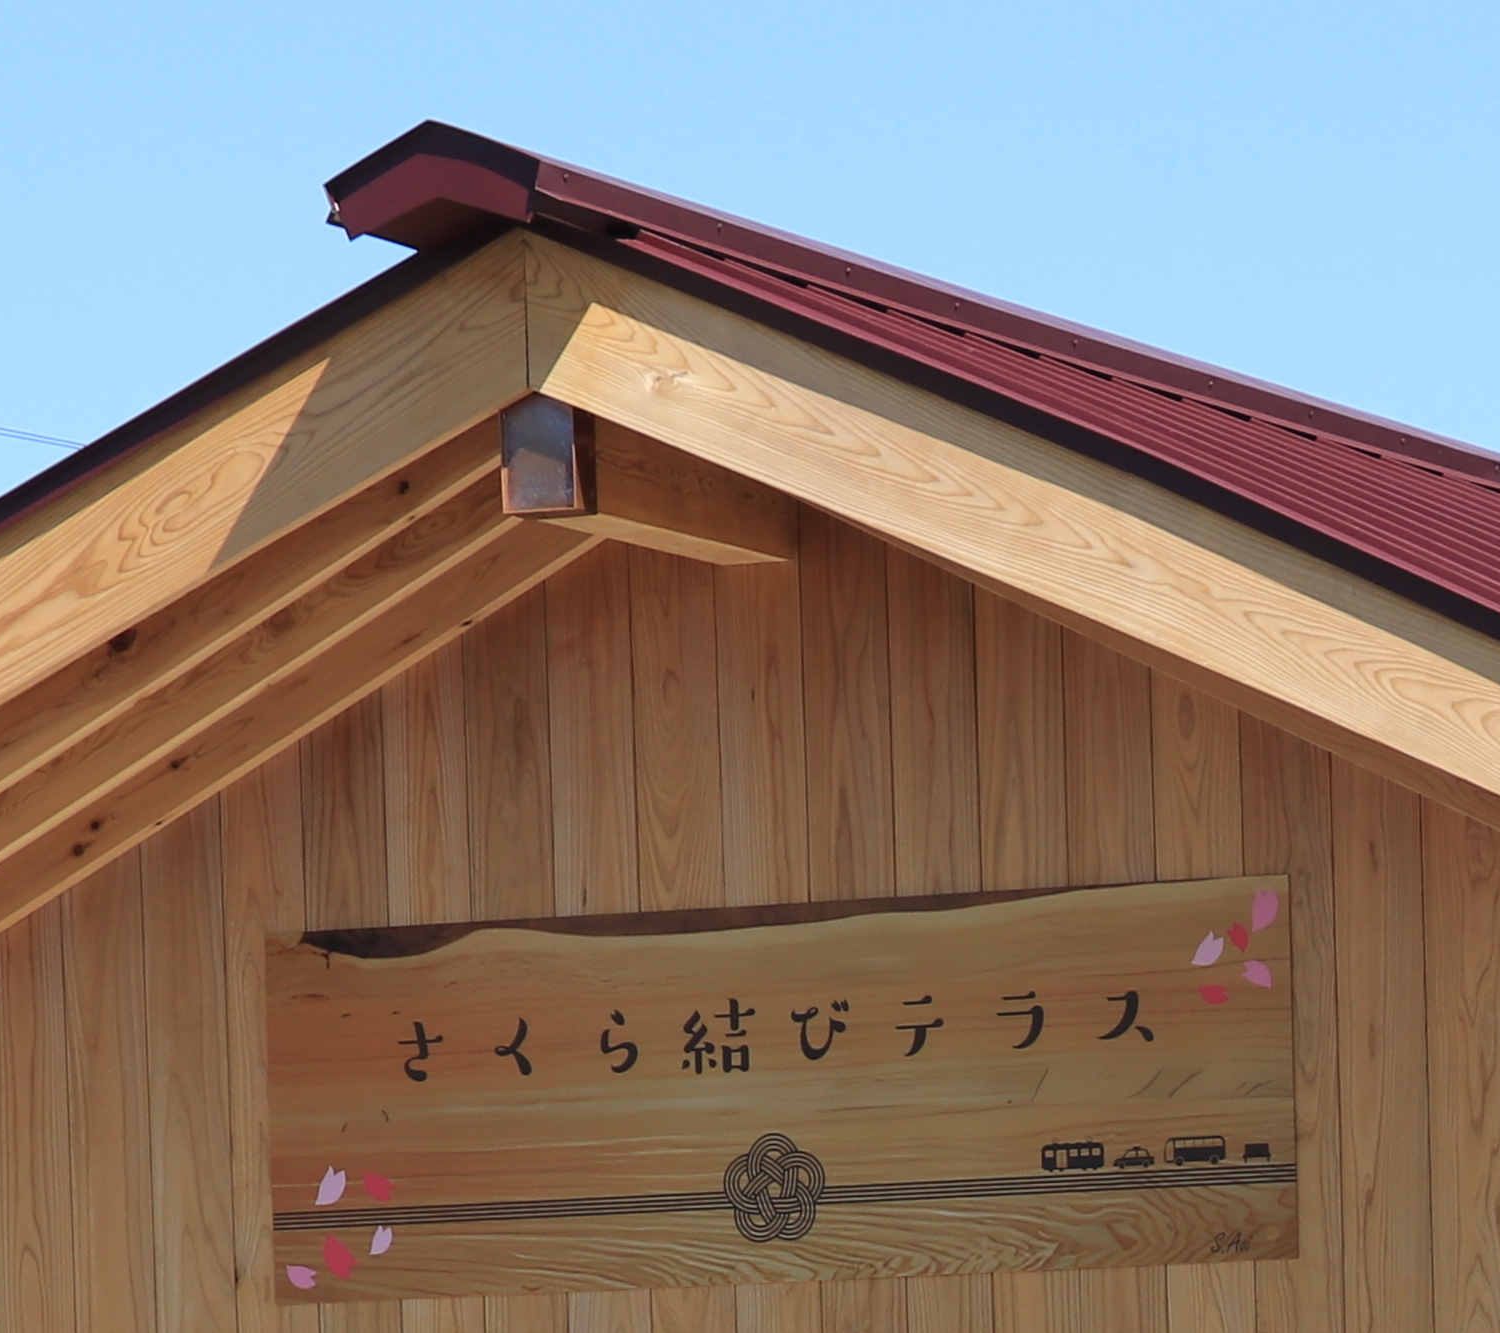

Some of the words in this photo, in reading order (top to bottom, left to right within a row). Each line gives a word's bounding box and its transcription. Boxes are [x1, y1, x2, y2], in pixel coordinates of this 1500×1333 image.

[397, 990, 1155, 1082] さくら結びテラス
